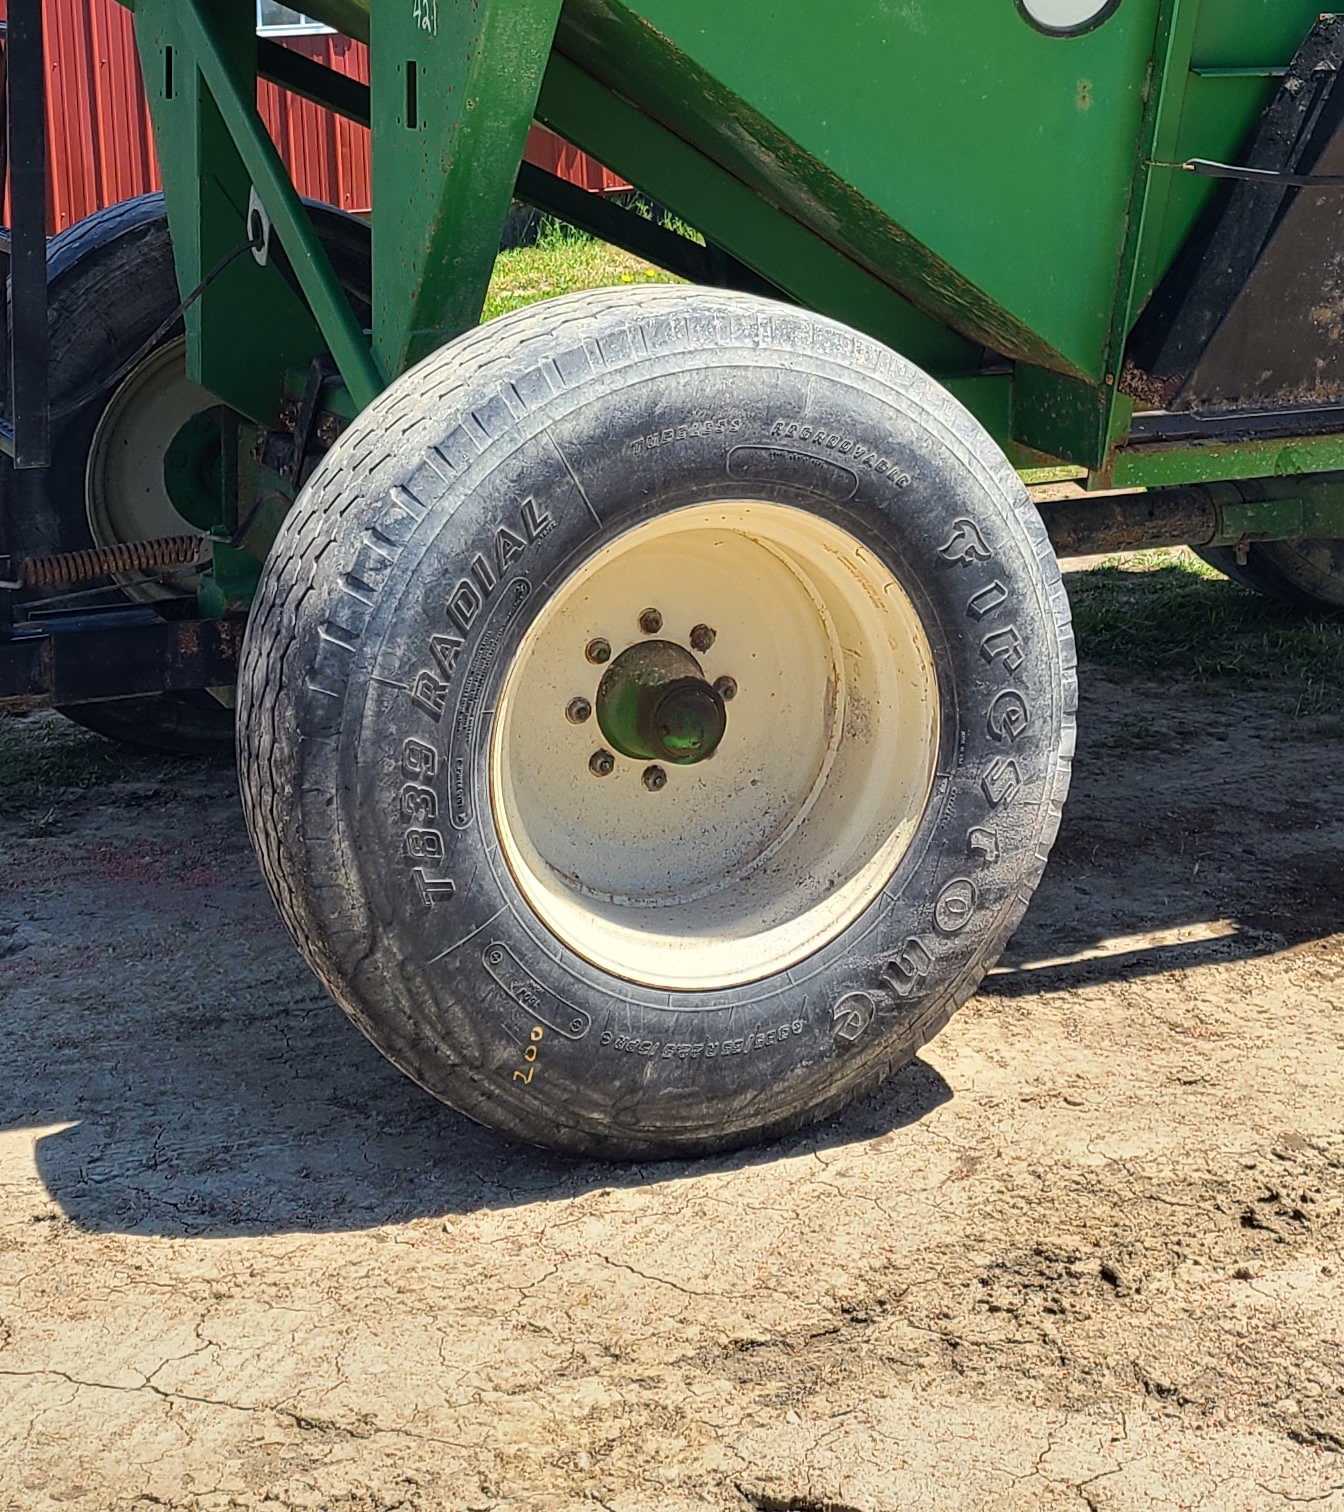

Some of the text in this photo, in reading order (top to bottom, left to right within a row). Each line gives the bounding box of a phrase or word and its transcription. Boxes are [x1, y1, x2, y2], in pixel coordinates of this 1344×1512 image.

[410, 496, 554, 722] RADIAL
[401, 736, 457, 908] T839
[832, 517, 1029, 1041] Firestone
